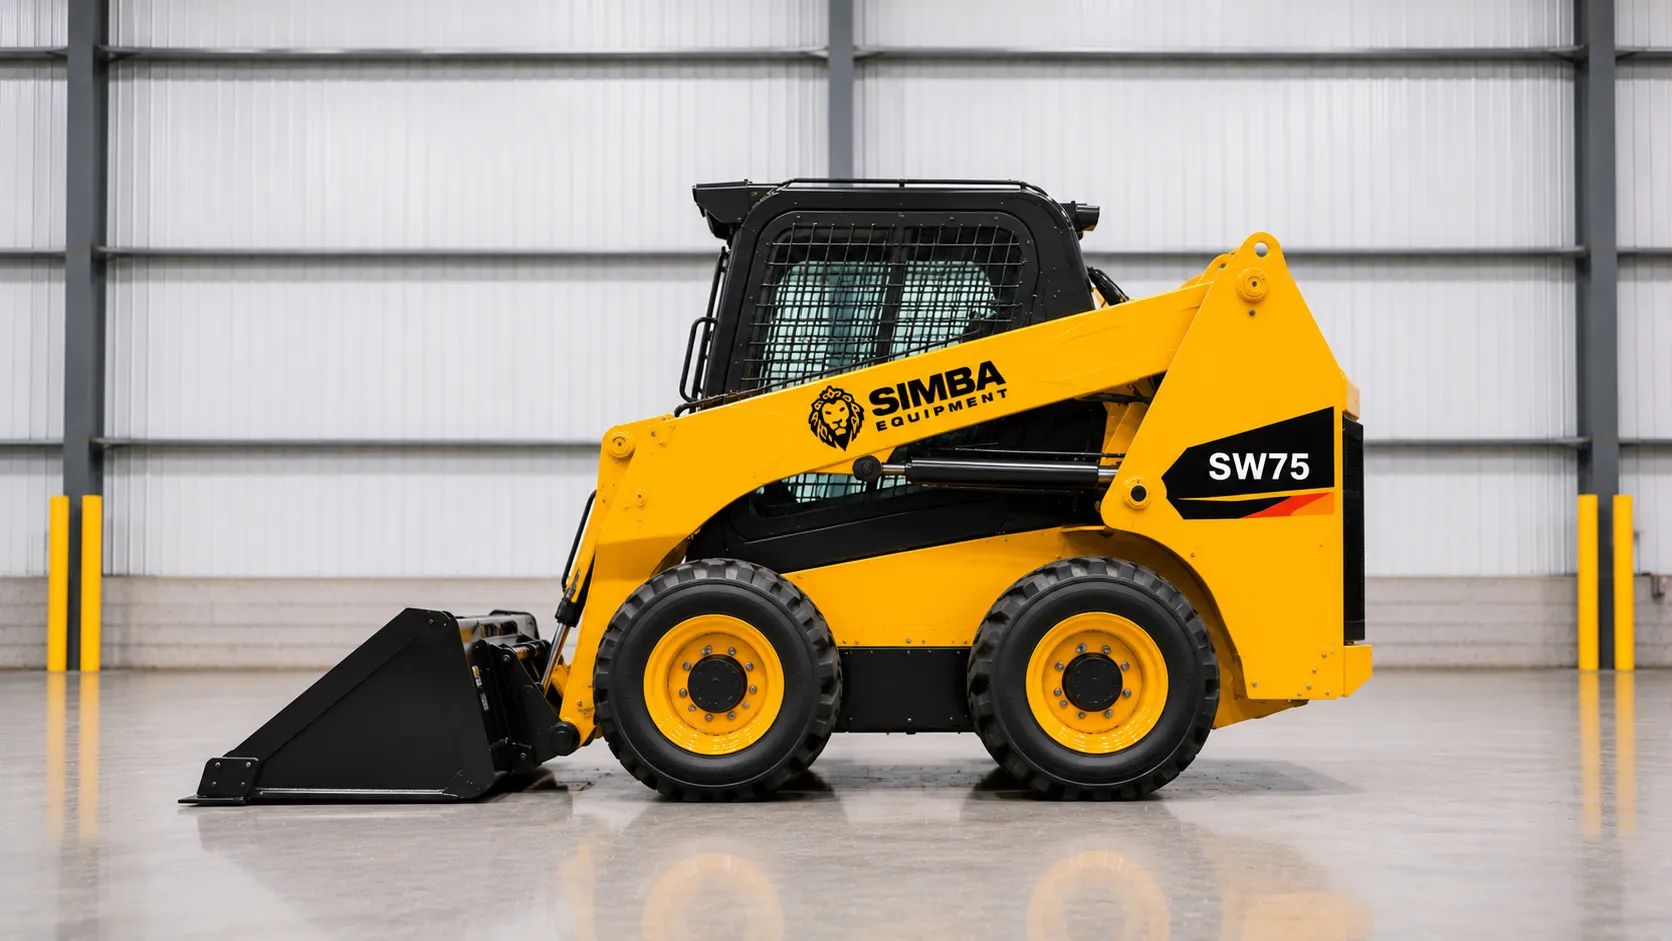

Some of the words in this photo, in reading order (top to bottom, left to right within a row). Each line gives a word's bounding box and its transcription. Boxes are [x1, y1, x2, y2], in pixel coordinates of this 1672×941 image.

[869, 360, 1006, 416] SIMBA
[876, 388, 1007, 432] EQUIPMENT
[1209, 452, 1310, 481] SW75
